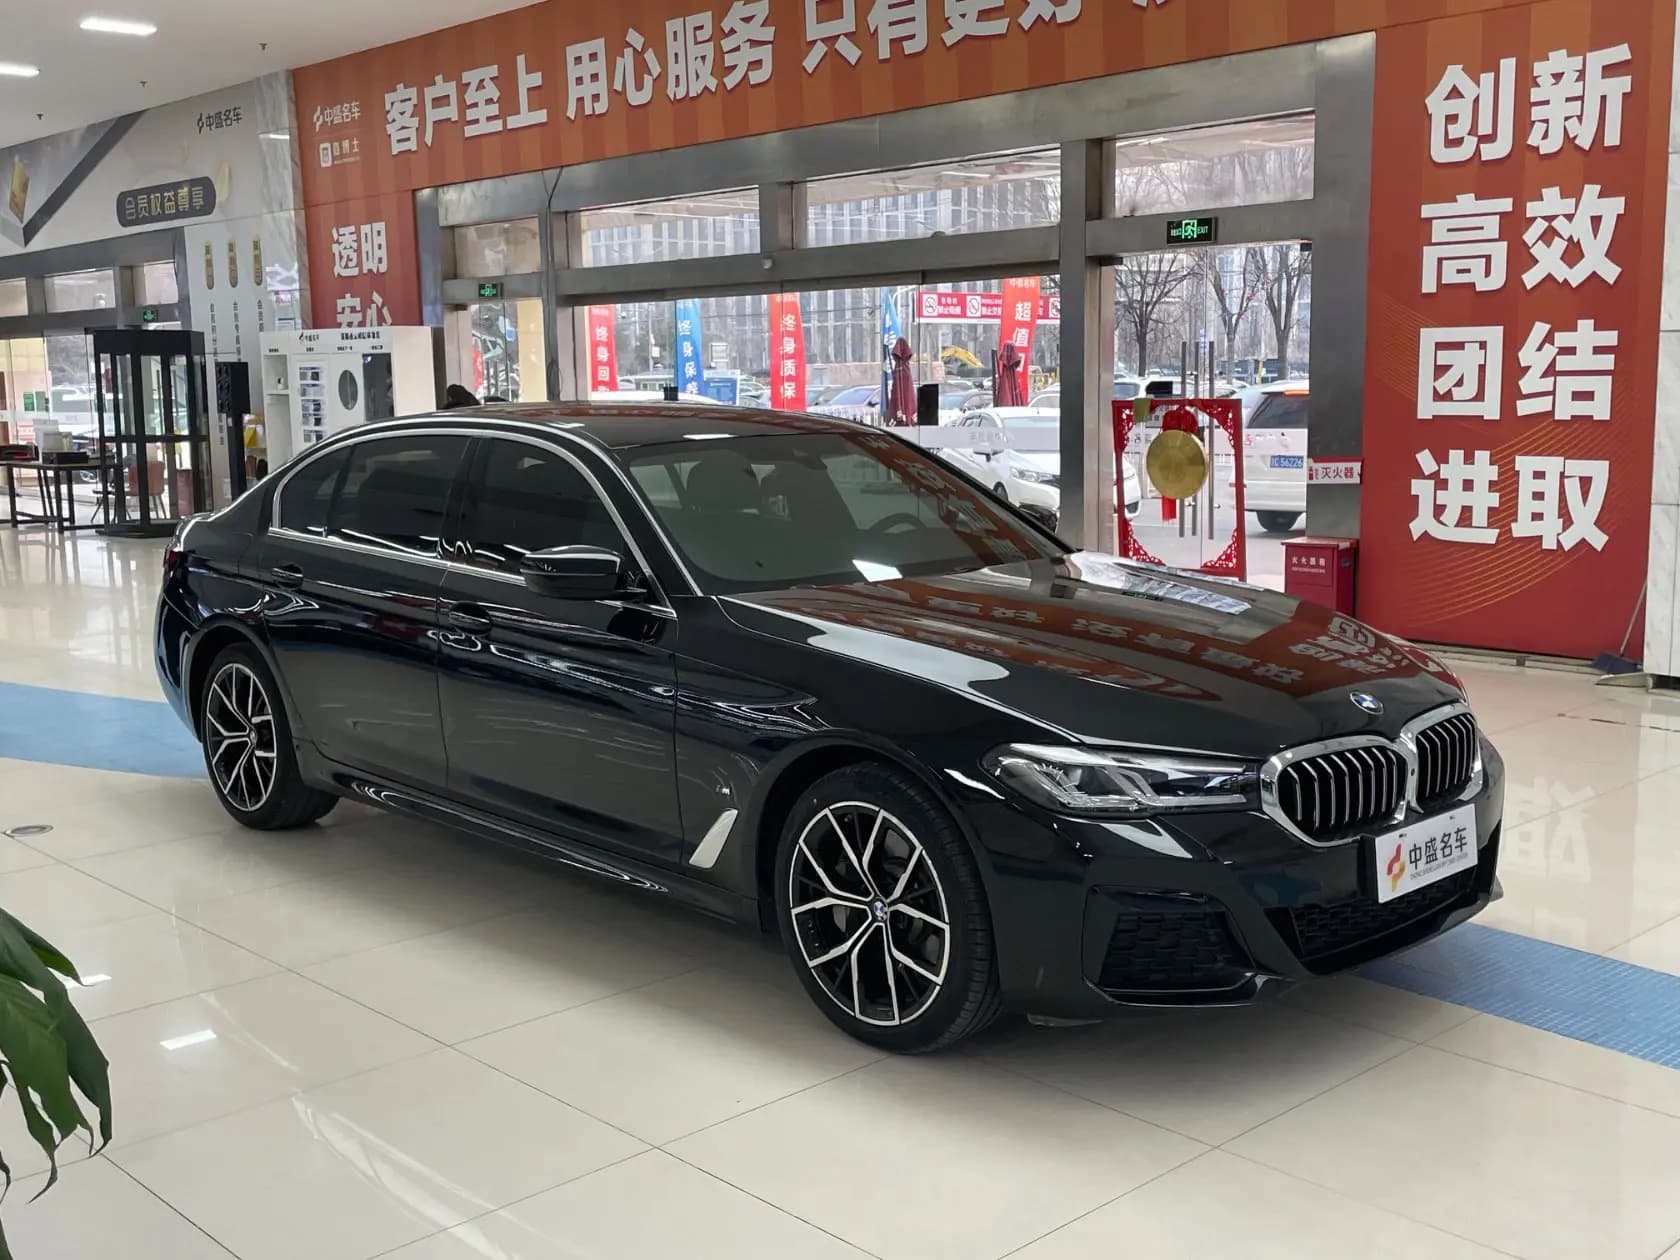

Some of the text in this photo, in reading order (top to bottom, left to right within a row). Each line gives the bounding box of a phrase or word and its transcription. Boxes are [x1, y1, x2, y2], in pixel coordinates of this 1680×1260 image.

[385, 54, 548, 155] 客户至上
[565, 0, 776, 120] 用心服务
[1425, 43, 1632, 163] 创新
[205, 105, 243, 129] 中盛名车
[325, 100, 360, 126] 中盛名车
[125, 185, 205, 220] 会员权益尊享
[332, 221, 388, 278] 透明
[1421, 184, 1625, 293] 高效
[336, 290, 392, 328] 安心
[780, 313, 797, 399] 终身质保
[1416, 319, 1619, 421] 团结
[1321, 466, 1354, 479] 灭火器
[1409, 449, 1610, 552] 进取
[1409, 827, 1468, 870] 中盛名车
